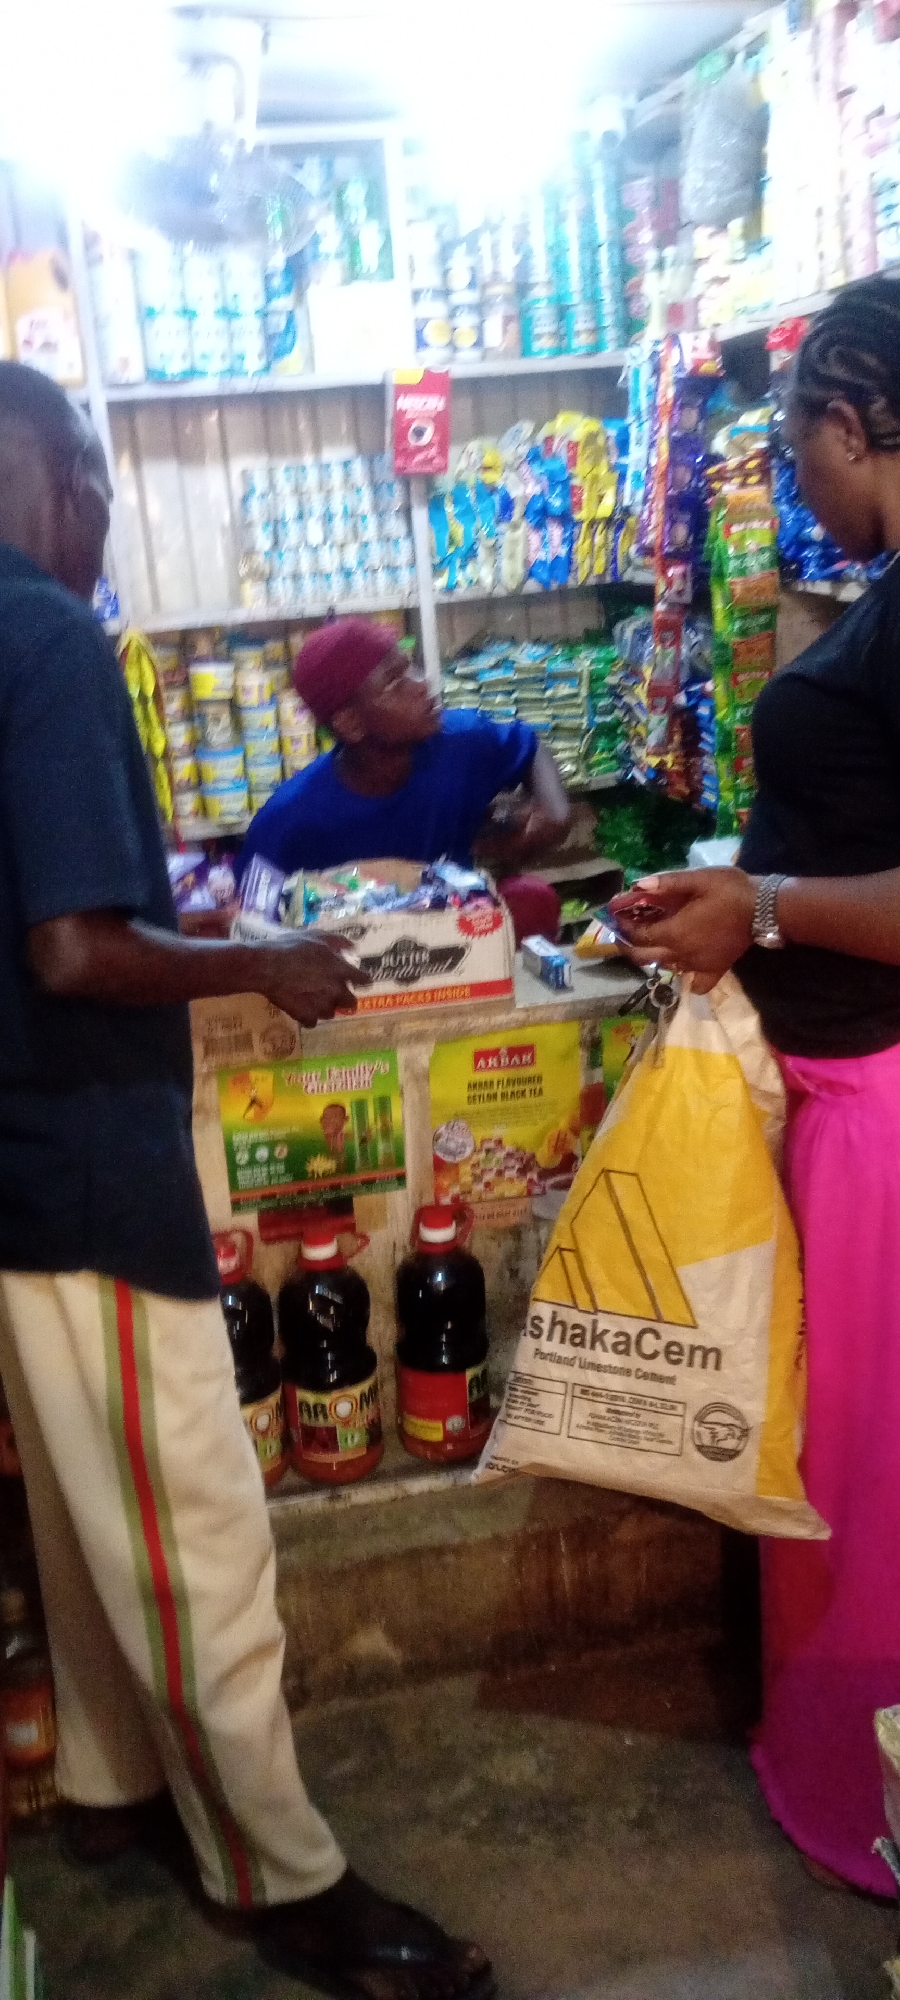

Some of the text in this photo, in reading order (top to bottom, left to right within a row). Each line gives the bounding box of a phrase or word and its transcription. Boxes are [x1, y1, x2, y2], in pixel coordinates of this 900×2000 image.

[357, 998, 394, 1011] EXTRA
[533, 1347, 676, 1386] Portland Limestone Cement
